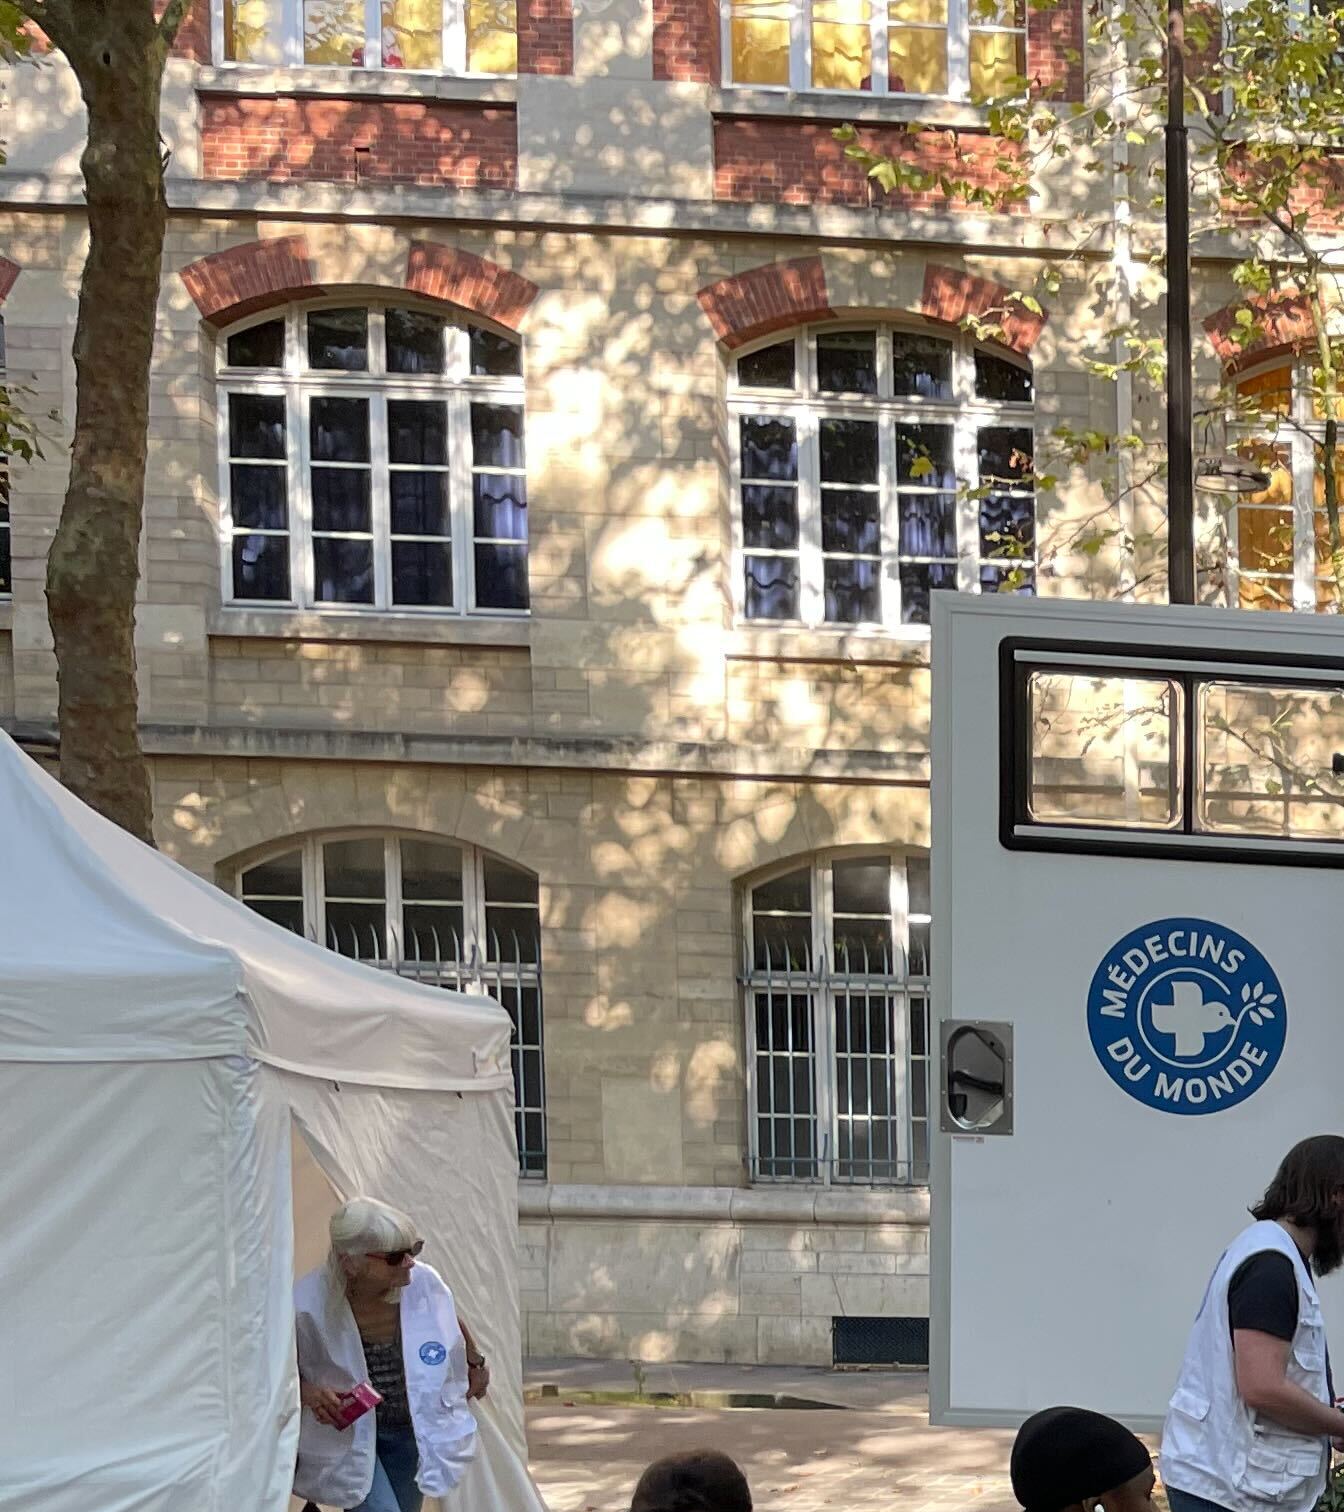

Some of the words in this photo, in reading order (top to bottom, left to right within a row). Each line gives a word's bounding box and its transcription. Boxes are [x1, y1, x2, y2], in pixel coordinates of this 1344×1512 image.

[1100, 931, 1246, 1019] MÉDECINS
[1107, 1036, 1151, 1082] DU
[1154, 1041, 1269, 1104] MONDE
